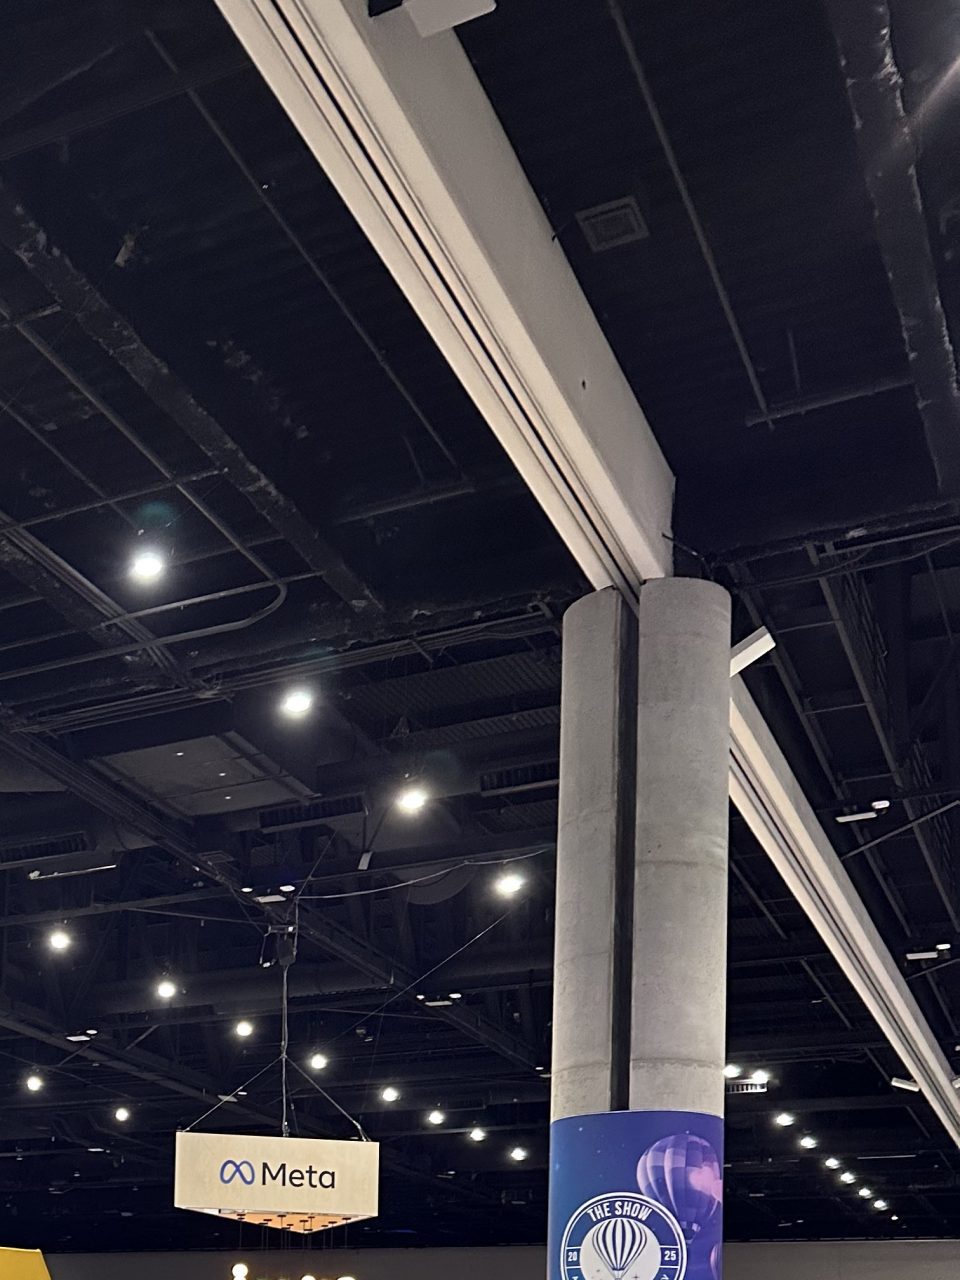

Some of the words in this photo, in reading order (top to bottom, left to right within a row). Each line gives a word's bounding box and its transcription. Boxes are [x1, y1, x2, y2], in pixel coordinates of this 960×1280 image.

[262, 1162, 335, 1188] Meta
[587, 1203, 611, 1222] THE
[614, 1201, 652, 1221] SHOW
[568, 1252, 578, 1262] 20
[664, 1251, 676, 1261] 25
